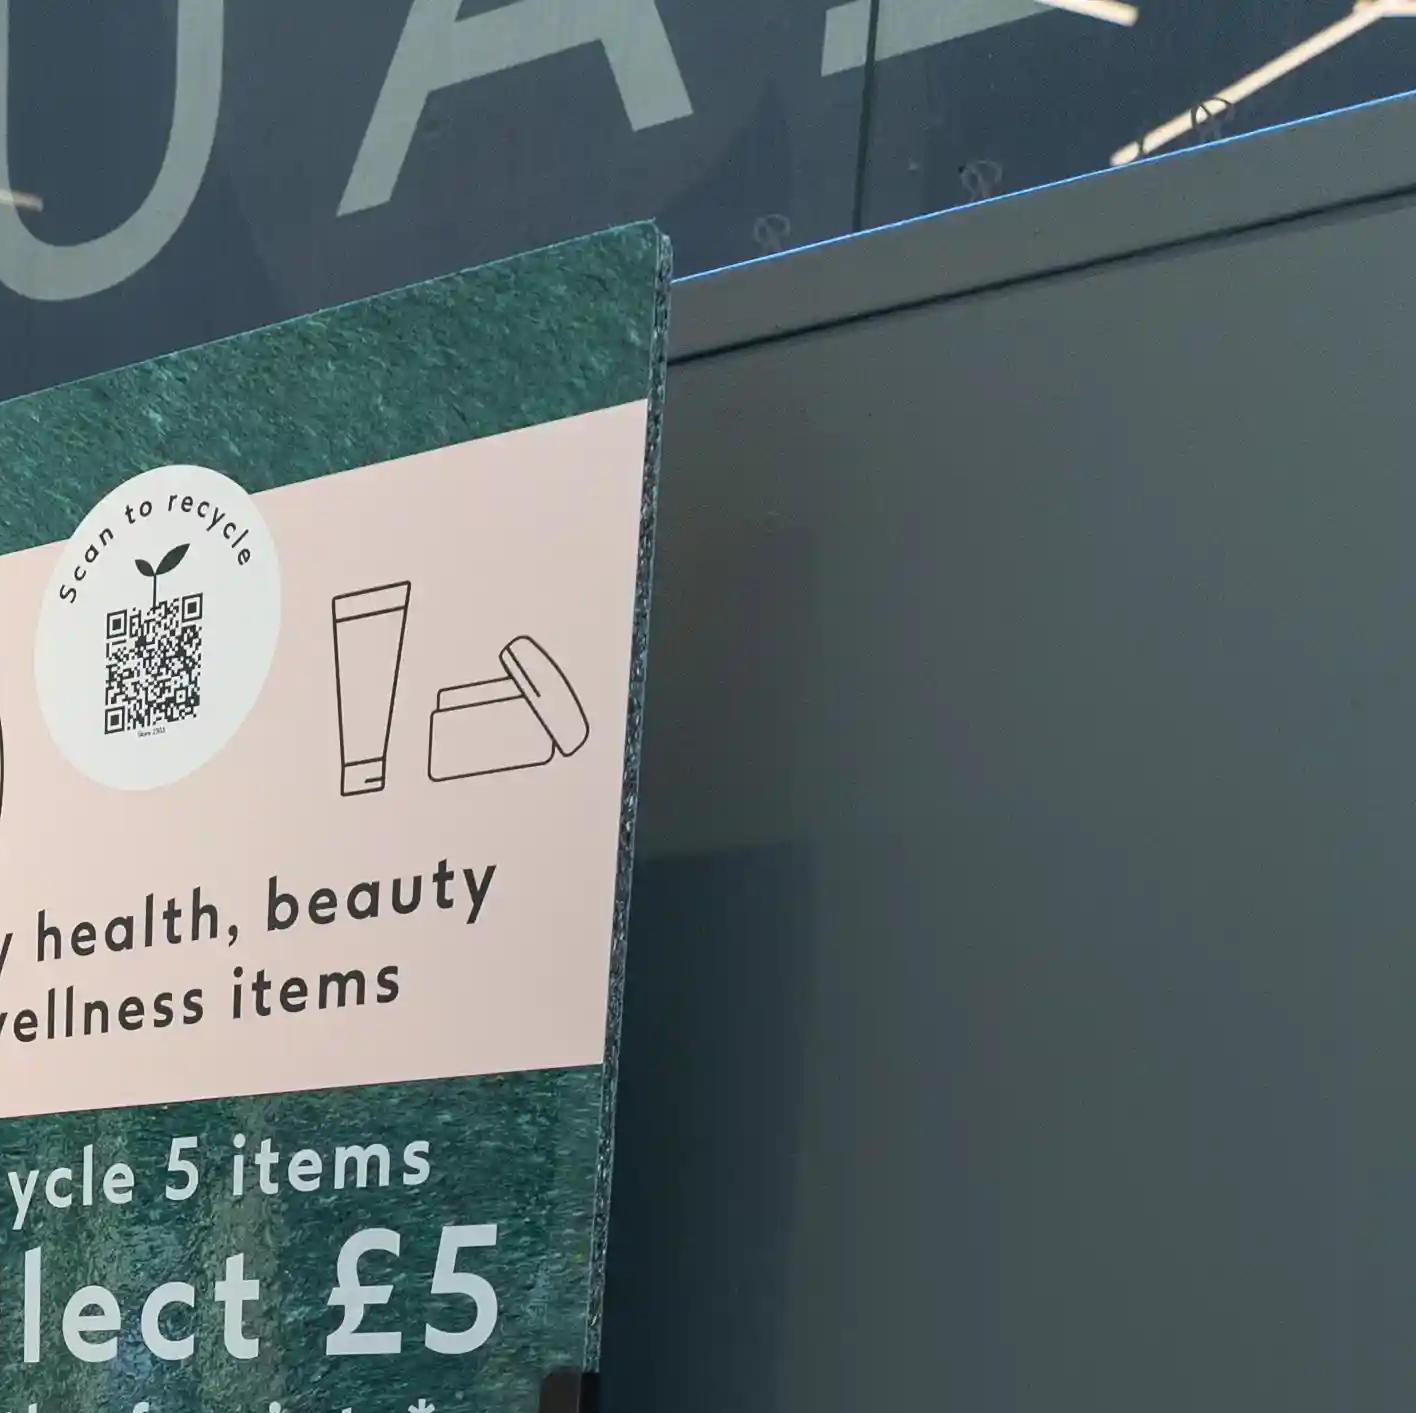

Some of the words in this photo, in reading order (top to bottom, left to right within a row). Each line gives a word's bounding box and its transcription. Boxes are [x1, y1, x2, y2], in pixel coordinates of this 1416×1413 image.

[59, 526, 114, 604] Scan
[124, 499, 153, 525] to
[167, 493, 252, 566] recycle
[36, 886, 241, 963] health,
[267, 859, 497, 933] beauty
[232, 964, 401, 1036] items
[165, 1135, 200, 1201] 5
[232, 1132, 432, 1197] items
[325, 1222, 499, 1357] £5
